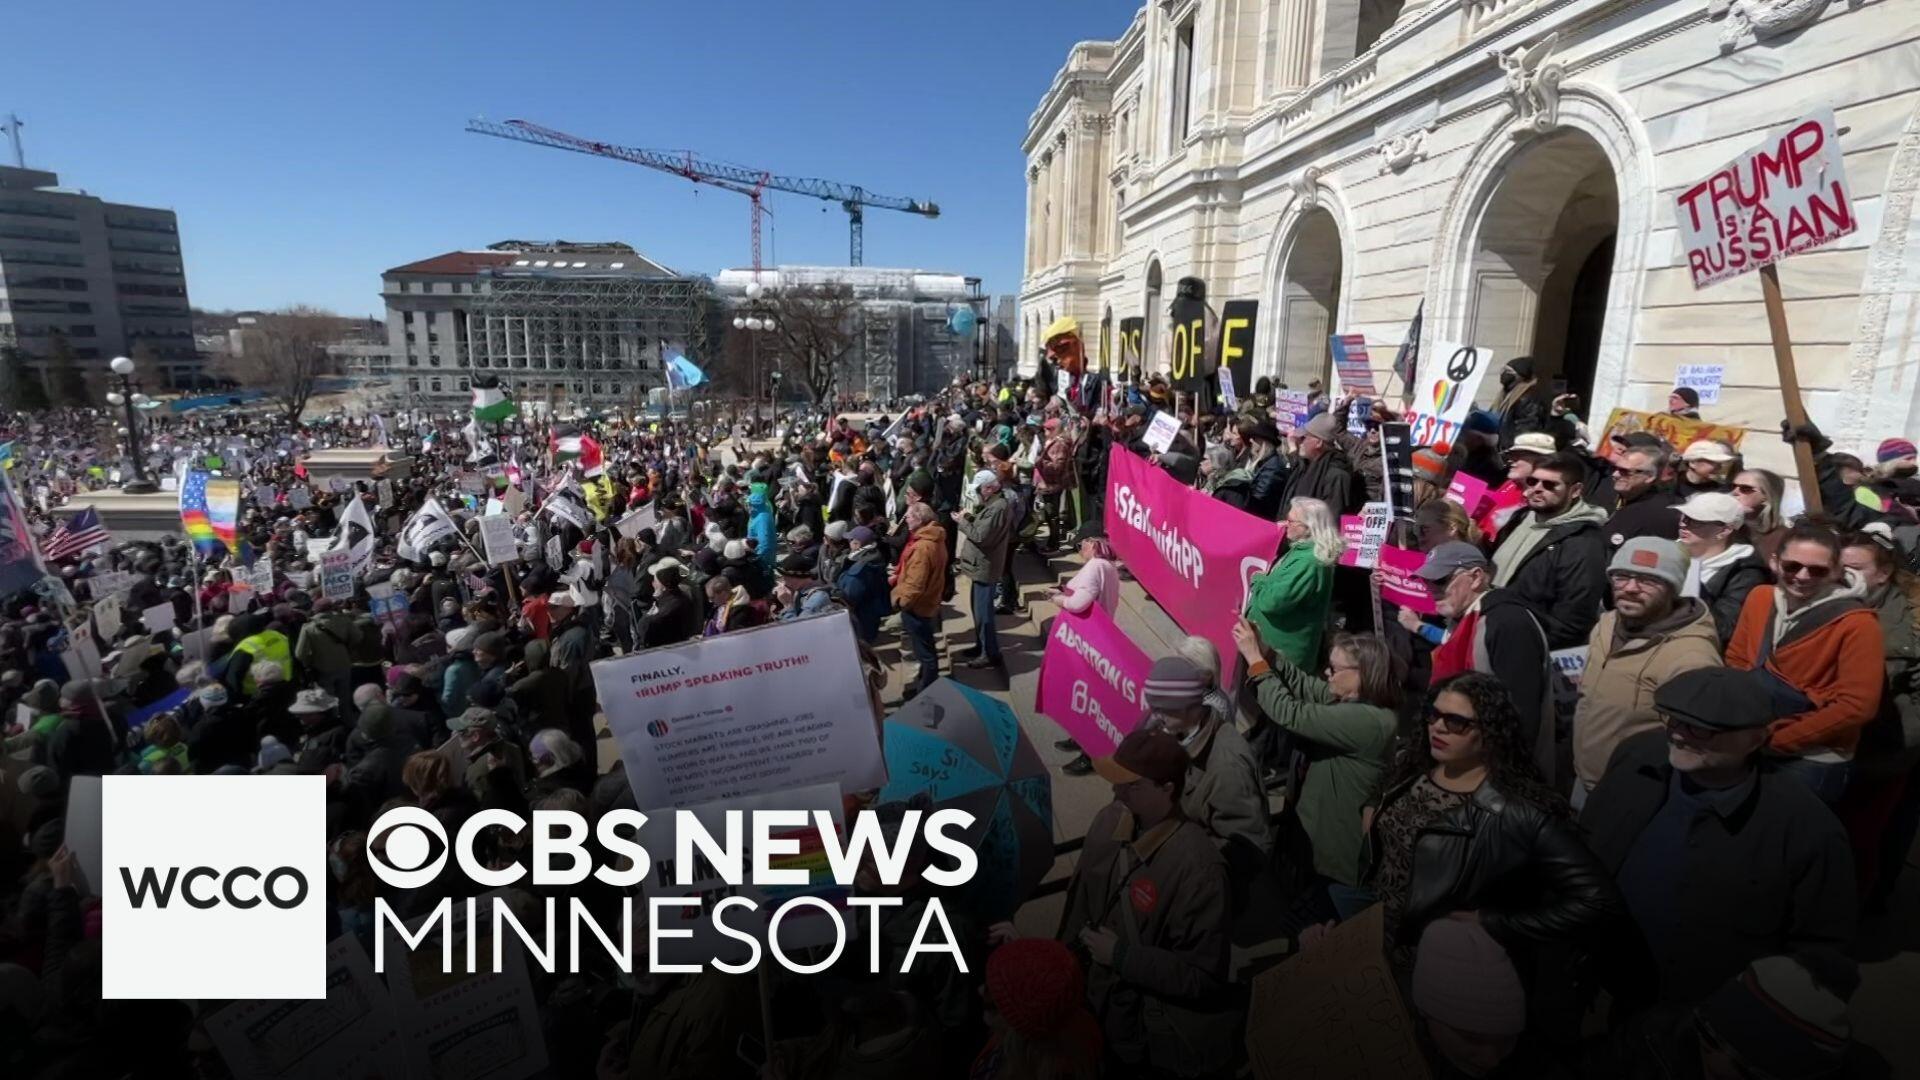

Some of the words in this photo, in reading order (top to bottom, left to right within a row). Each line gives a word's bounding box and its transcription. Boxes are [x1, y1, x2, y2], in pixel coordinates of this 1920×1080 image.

[1678, 120, 1823, 232] TRUMP
[1688, 180, 1852, 281] RUSSIAN
[1717, 214, 1738, 239] IS
[1752, 203, 1774, 227] A
[1173, 317, 1249, 380] OFF
[1404, 409, 1463, 447] RESIST
[685, 666, 753, 688] SPEAKING
[1055, 621, 1121, 690] ABORTION
[1122, 677, 1136, 704] IS
